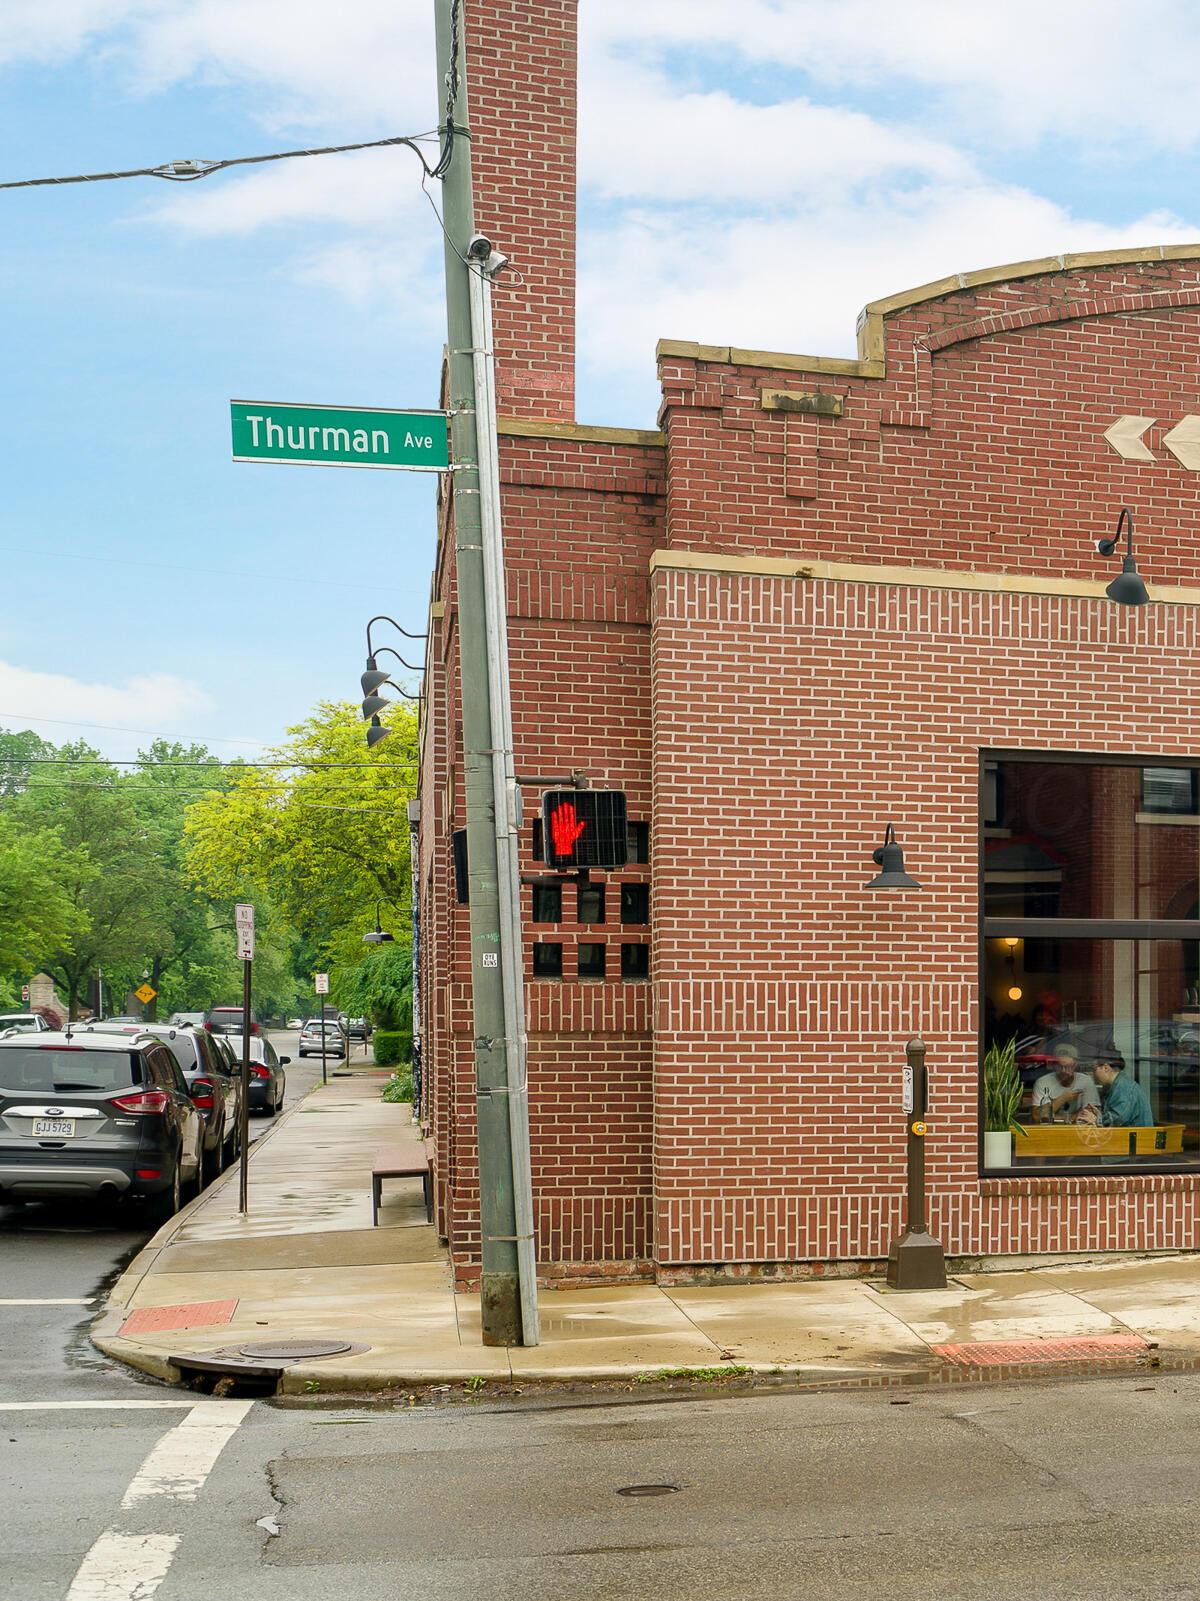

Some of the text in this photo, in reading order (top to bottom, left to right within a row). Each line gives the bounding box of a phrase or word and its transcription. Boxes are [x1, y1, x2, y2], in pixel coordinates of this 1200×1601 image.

[246, 415, 433, 454] Thurman Ave
[52, 1122, 72, 1133] 5729
